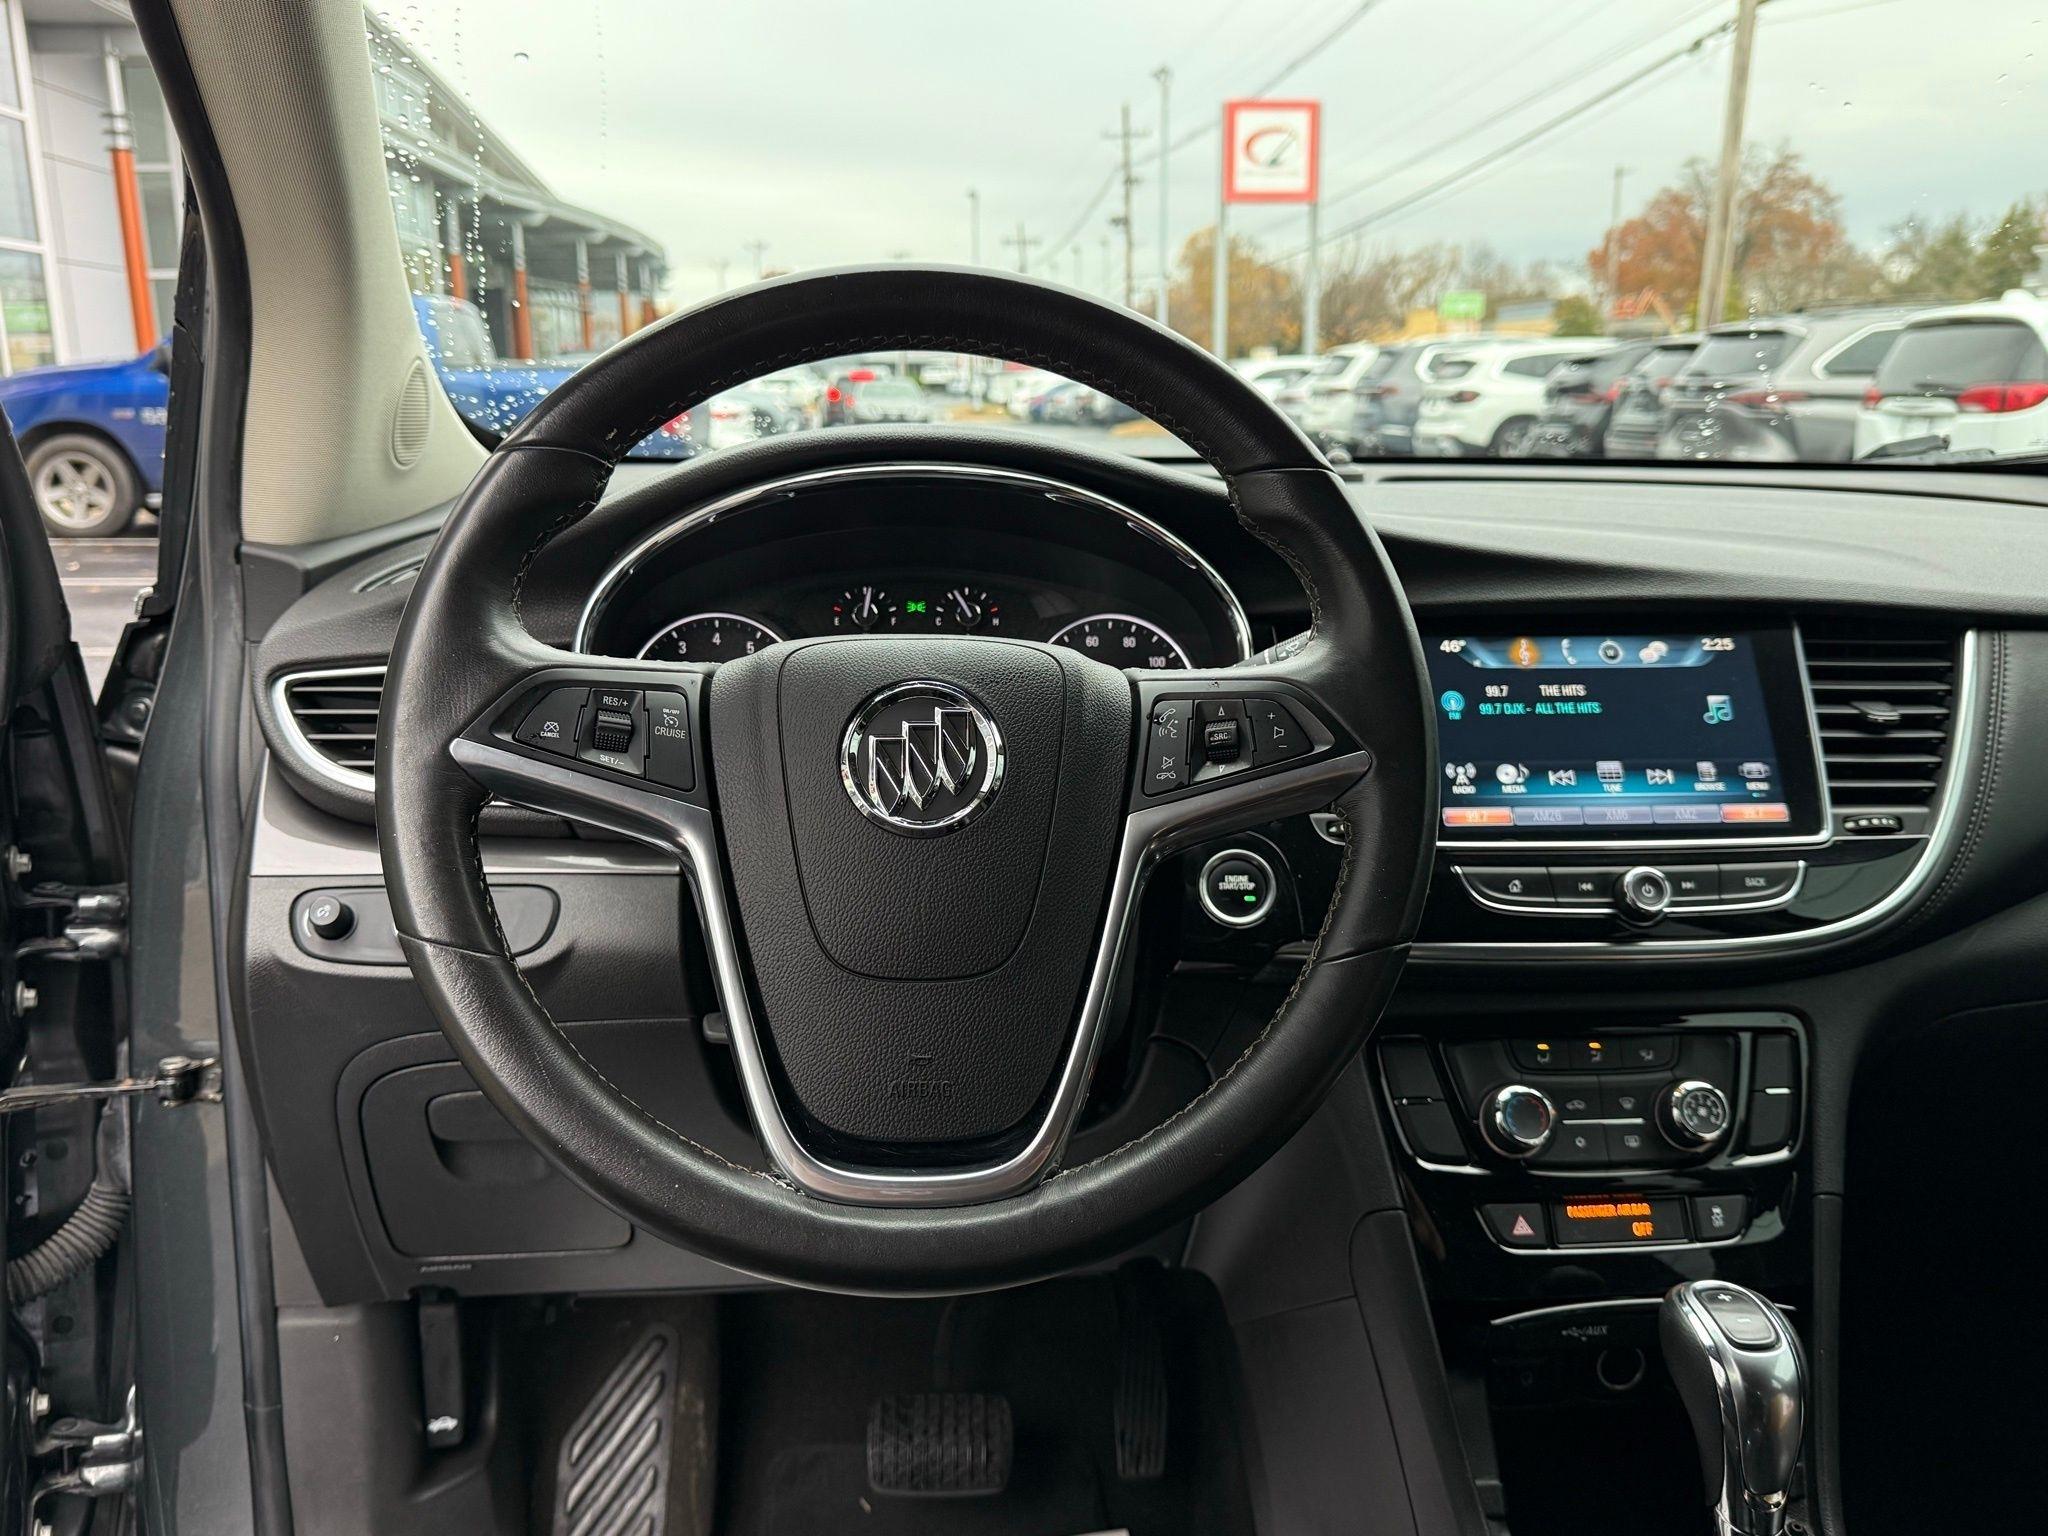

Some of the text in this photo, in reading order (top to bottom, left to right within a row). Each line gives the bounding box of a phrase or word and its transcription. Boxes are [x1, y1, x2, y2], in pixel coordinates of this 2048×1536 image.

[833, 617, 840, 626] E
[890, 616, 897, 626] F
[935, 617, 942, 626] C
[992, 618, 1000, 626] H
[712, 632, 721, 645] 4
[1085, 636, 1099, 647] 60
[1122, 636, 1137, 648] 80
[678, 641, 687, 654] 3
[1148, 656, 1166, 668] 100
[1485, 684, 1509, 697] 99.7
[1539, 684, 1587, 697] THE HITS
[1479, 702, 1502, 715] 99.7
[1555, 702, 1577, 715] THE
[1577, 701, 1602, 715] HITS
[654, 726, 686, 739] CRUISE
[1214, 732, 1228, 740] SRC
[889, 1080, 951, 1098] AIRBAG
